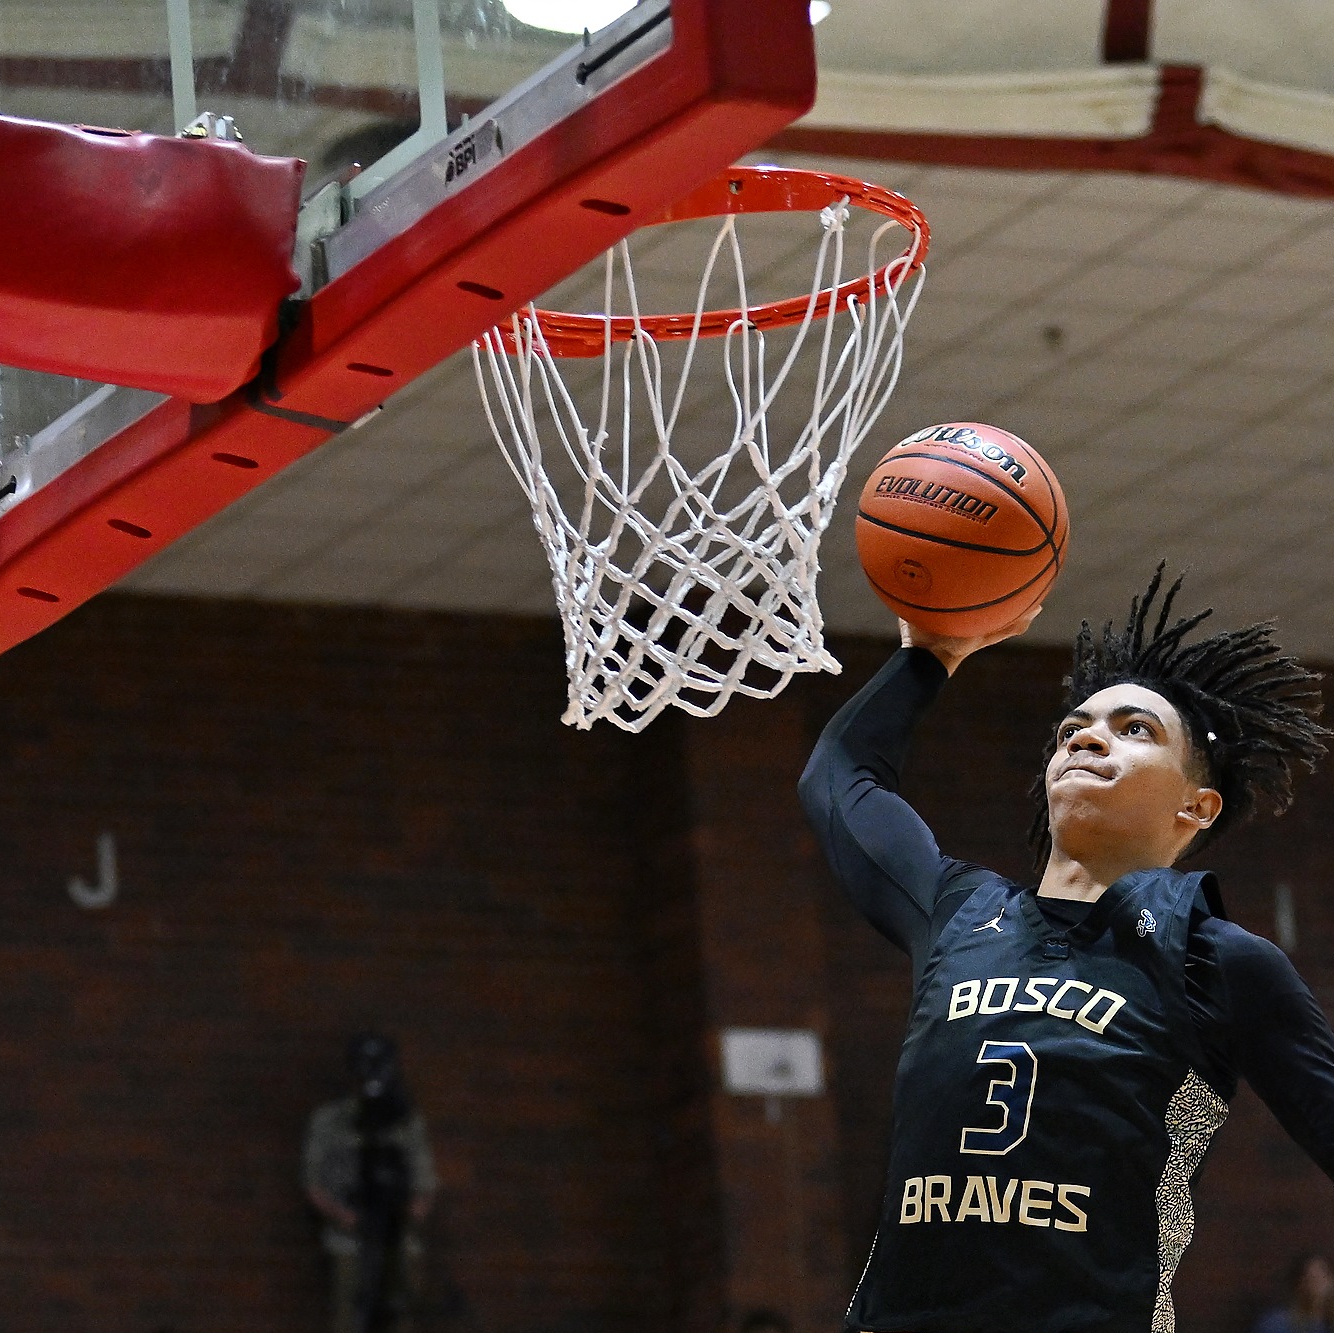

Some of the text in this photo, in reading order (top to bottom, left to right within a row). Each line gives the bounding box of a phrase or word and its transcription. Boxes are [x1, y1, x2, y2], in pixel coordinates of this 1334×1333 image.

[875, 476, 999, 520] EVOLUTION
[69, 831, 117, 909] J
[947, 976, 1126, 1034] BOSCO
[959, 1041, 1038, 1155] 3
[899, 1174, 1091, 1232] BRAVES
